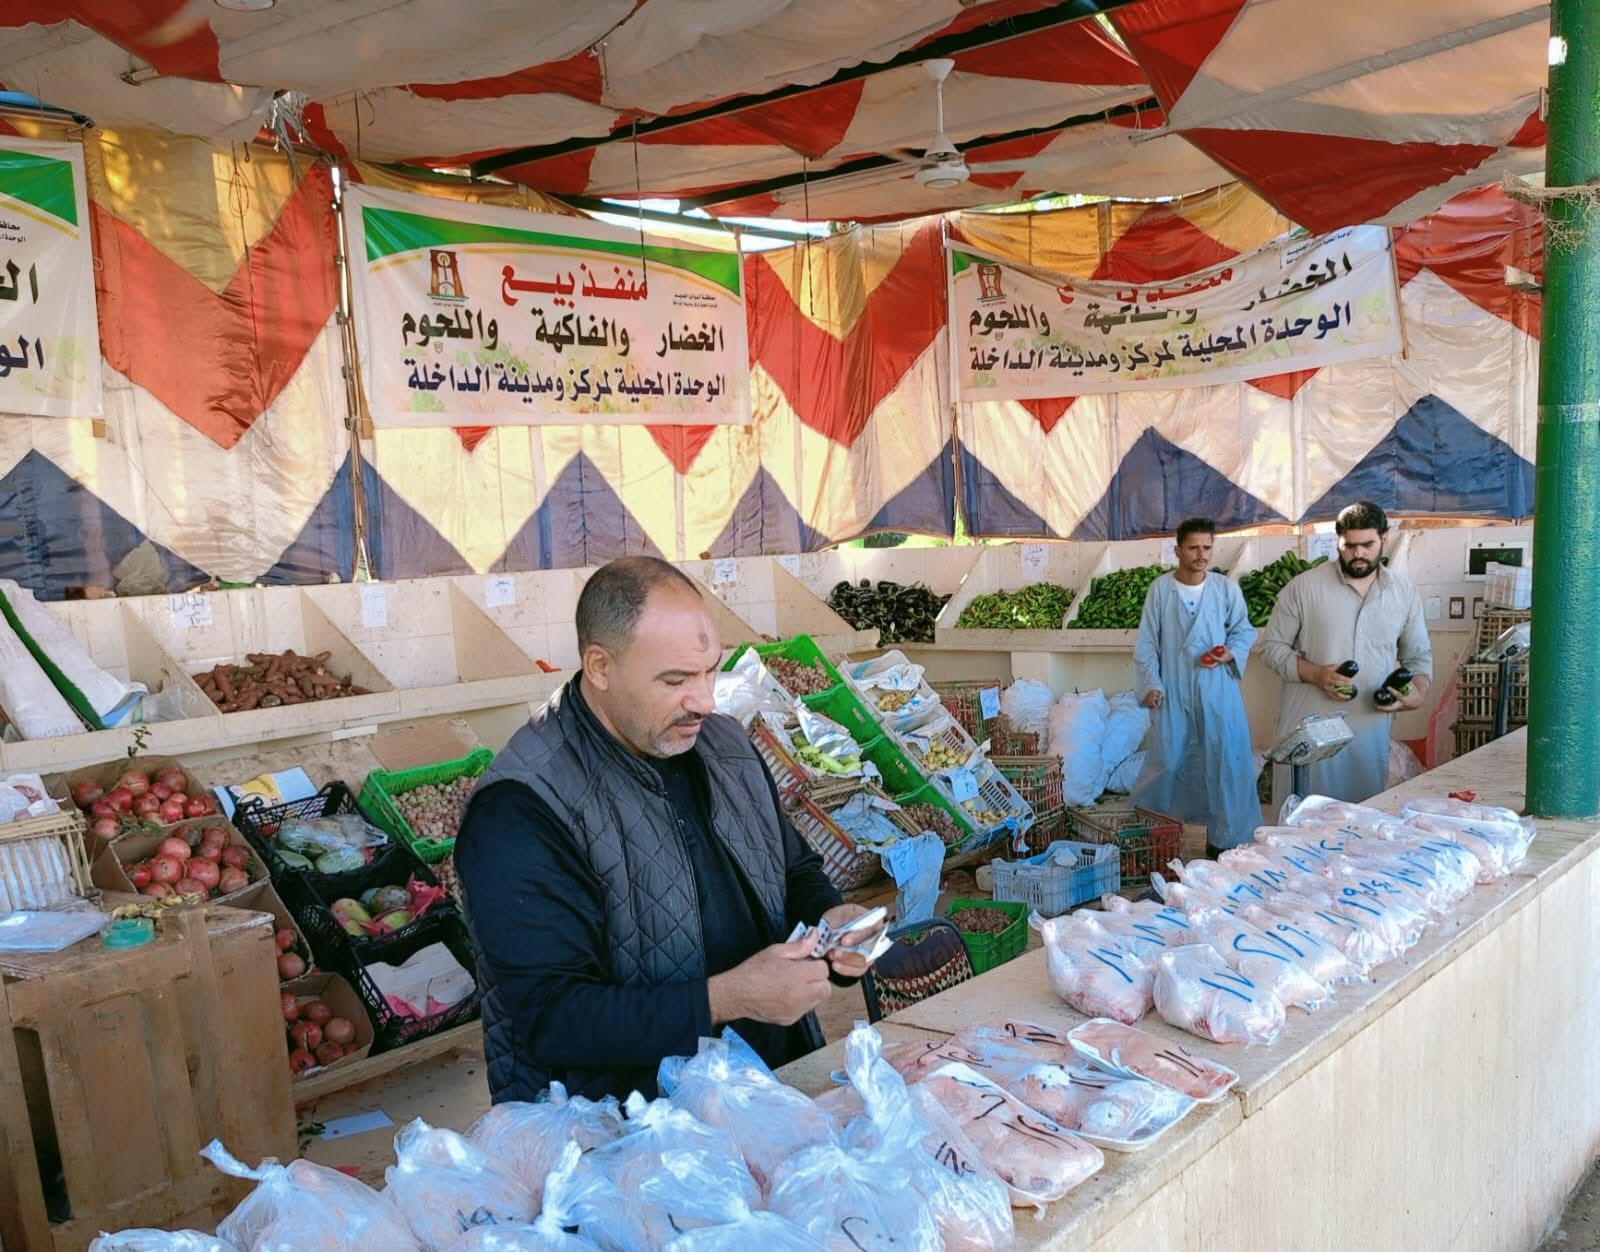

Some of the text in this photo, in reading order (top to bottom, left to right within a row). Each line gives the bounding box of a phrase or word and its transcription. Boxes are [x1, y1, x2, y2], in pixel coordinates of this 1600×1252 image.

[0, 258, 39, 305] ال
[501, 263, 648, 309] منفذ بيع
[402, 307, 725, 358] الخضار والفاكهة واللحوم
[969, 303, 1051, 337] واللحوم
[969, 300, 1352, 377] الوحدة المحلية لمركز ومدينة الداخلة
[403, 357, 726, 404] الوحدة المحلية لمركز ومدينة الداخلة
